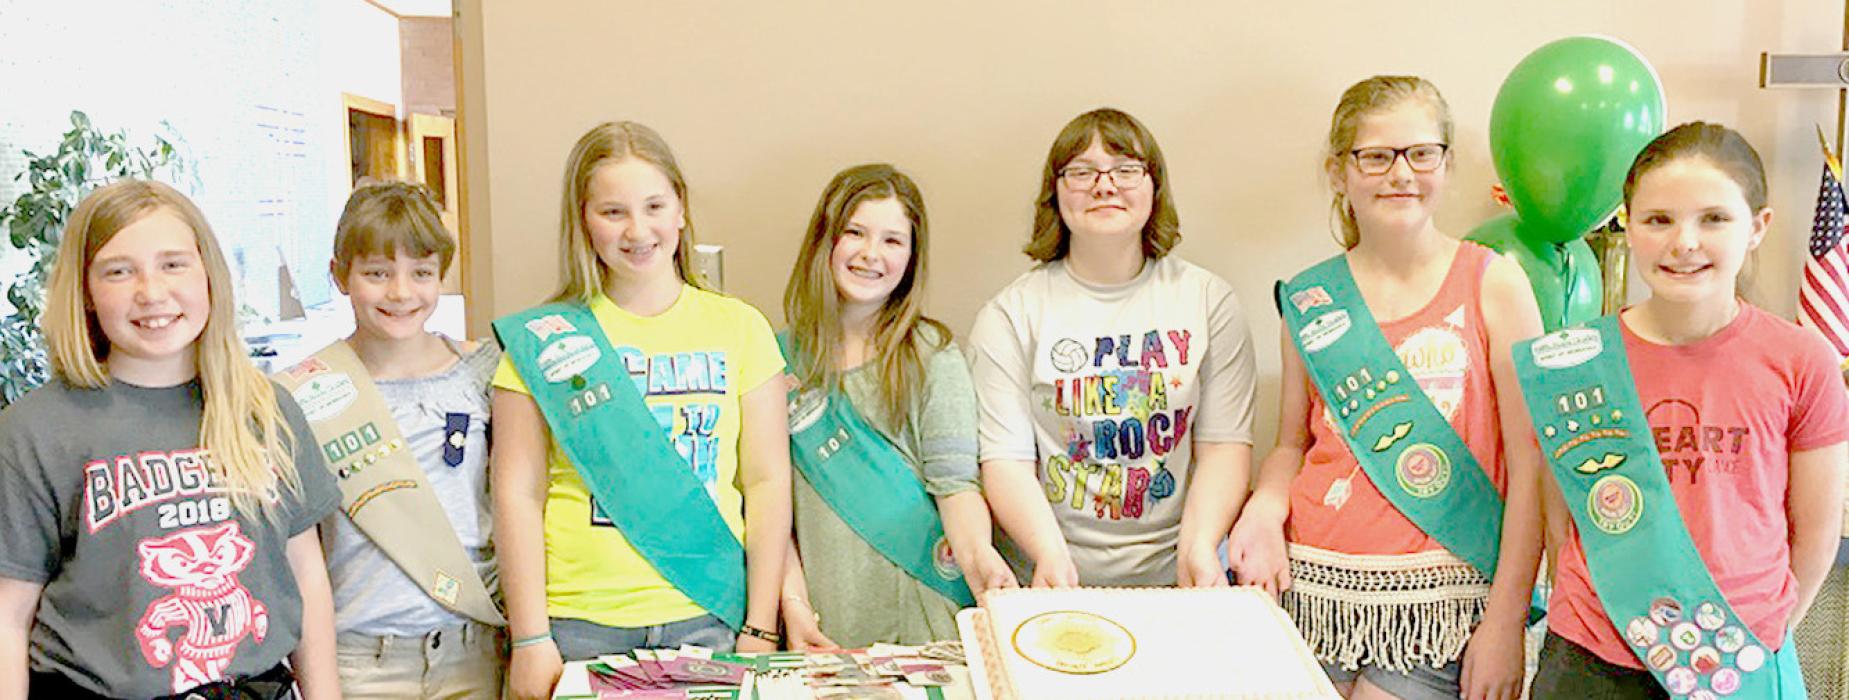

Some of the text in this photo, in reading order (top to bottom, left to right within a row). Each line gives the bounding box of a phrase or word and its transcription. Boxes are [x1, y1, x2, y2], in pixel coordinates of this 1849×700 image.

[1093, 329, 1192, 370] PLAY
[570, 383, 612, 416] 101
[1055, 371, 1168, 417] LIKE A
[1335, 367, 1373, 400] 101
[1557, 386, 1605, 413] 101
[324, 422, 381, 463] 101
[817, 427, 850, 460] 101
[1092, 405, 1192, 460] ROCK
[1651, 426, 1750, 454] EART
[1045, 453, 1151, 520] STAR
[1661, 455, 1705, 485] TY
[84, 448, 278, 532] BADGE
[157, 497, 231, 529] 2018
